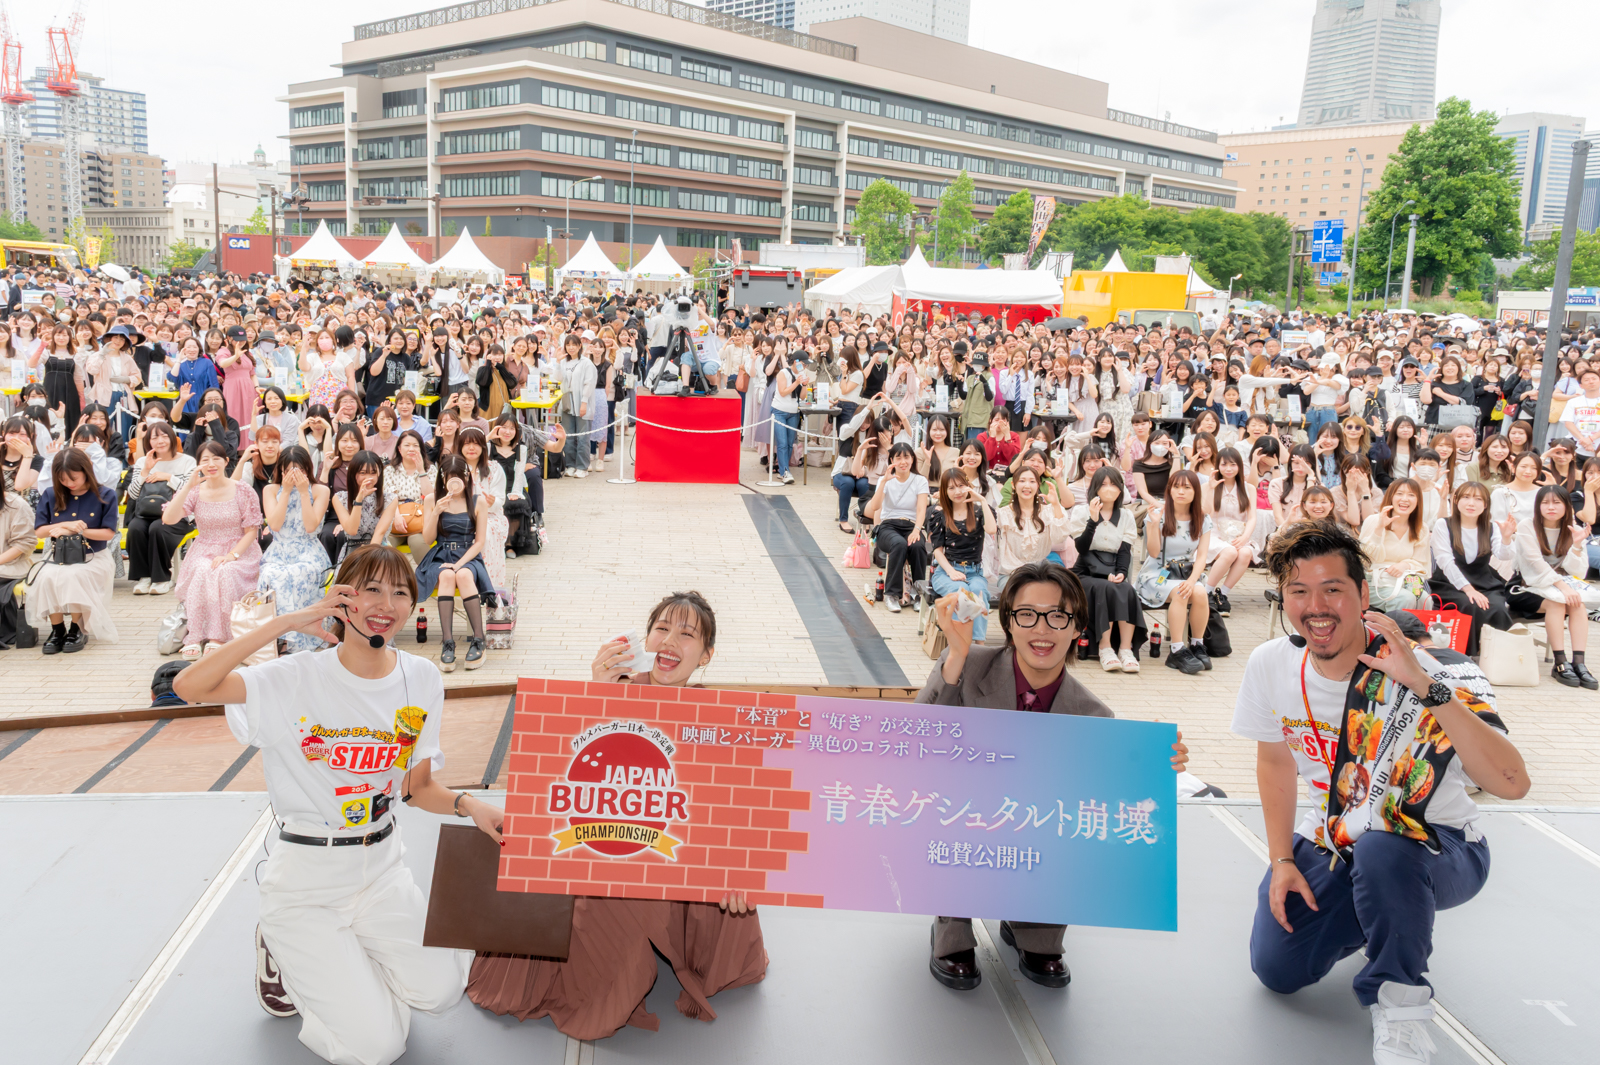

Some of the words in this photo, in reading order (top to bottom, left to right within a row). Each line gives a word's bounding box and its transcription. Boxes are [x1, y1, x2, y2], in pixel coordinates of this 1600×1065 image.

[229, 239, 250, 248] CAI
[302, 746, 330, 756] URGER
[573, 722, 675, 756] グルメバーガー日本一決定戦
[332, 746, 399, 770] STAFF
[601, 765, 673, 788] JAPAN
[549, 784, 688, 820] BURGER
[819, 780, 1158, 845] 青春ゲシュタルト崩壊
[575, 825, 659, 844] CHAMPIONSHIP
[926, 840, 1041, 871] 絶賛公開中
